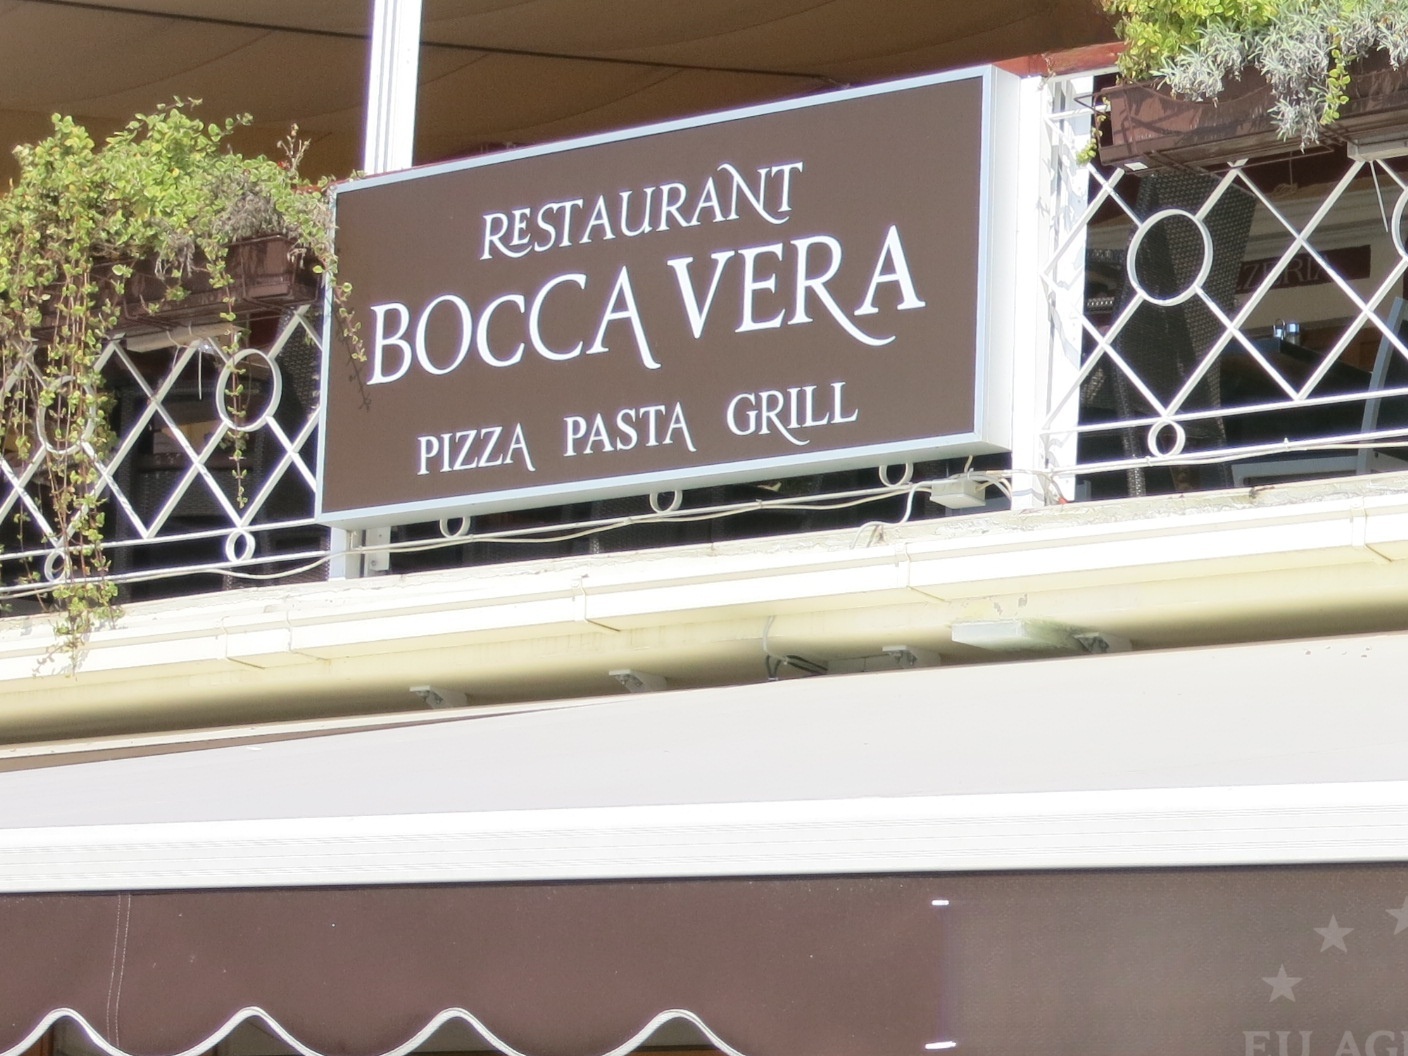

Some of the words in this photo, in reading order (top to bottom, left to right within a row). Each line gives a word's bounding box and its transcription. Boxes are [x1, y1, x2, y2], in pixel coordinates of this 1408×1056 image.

[480, 161, 803, 260] RESTAURANT
[366, 265, 661, 385] BOCCA
[667, 224, 926, 346] VERA
[416, 422, 536, 475] PIZZA
[563, 402, 697, 457] PASTA
[726, 382, 859, 446] GRILL
